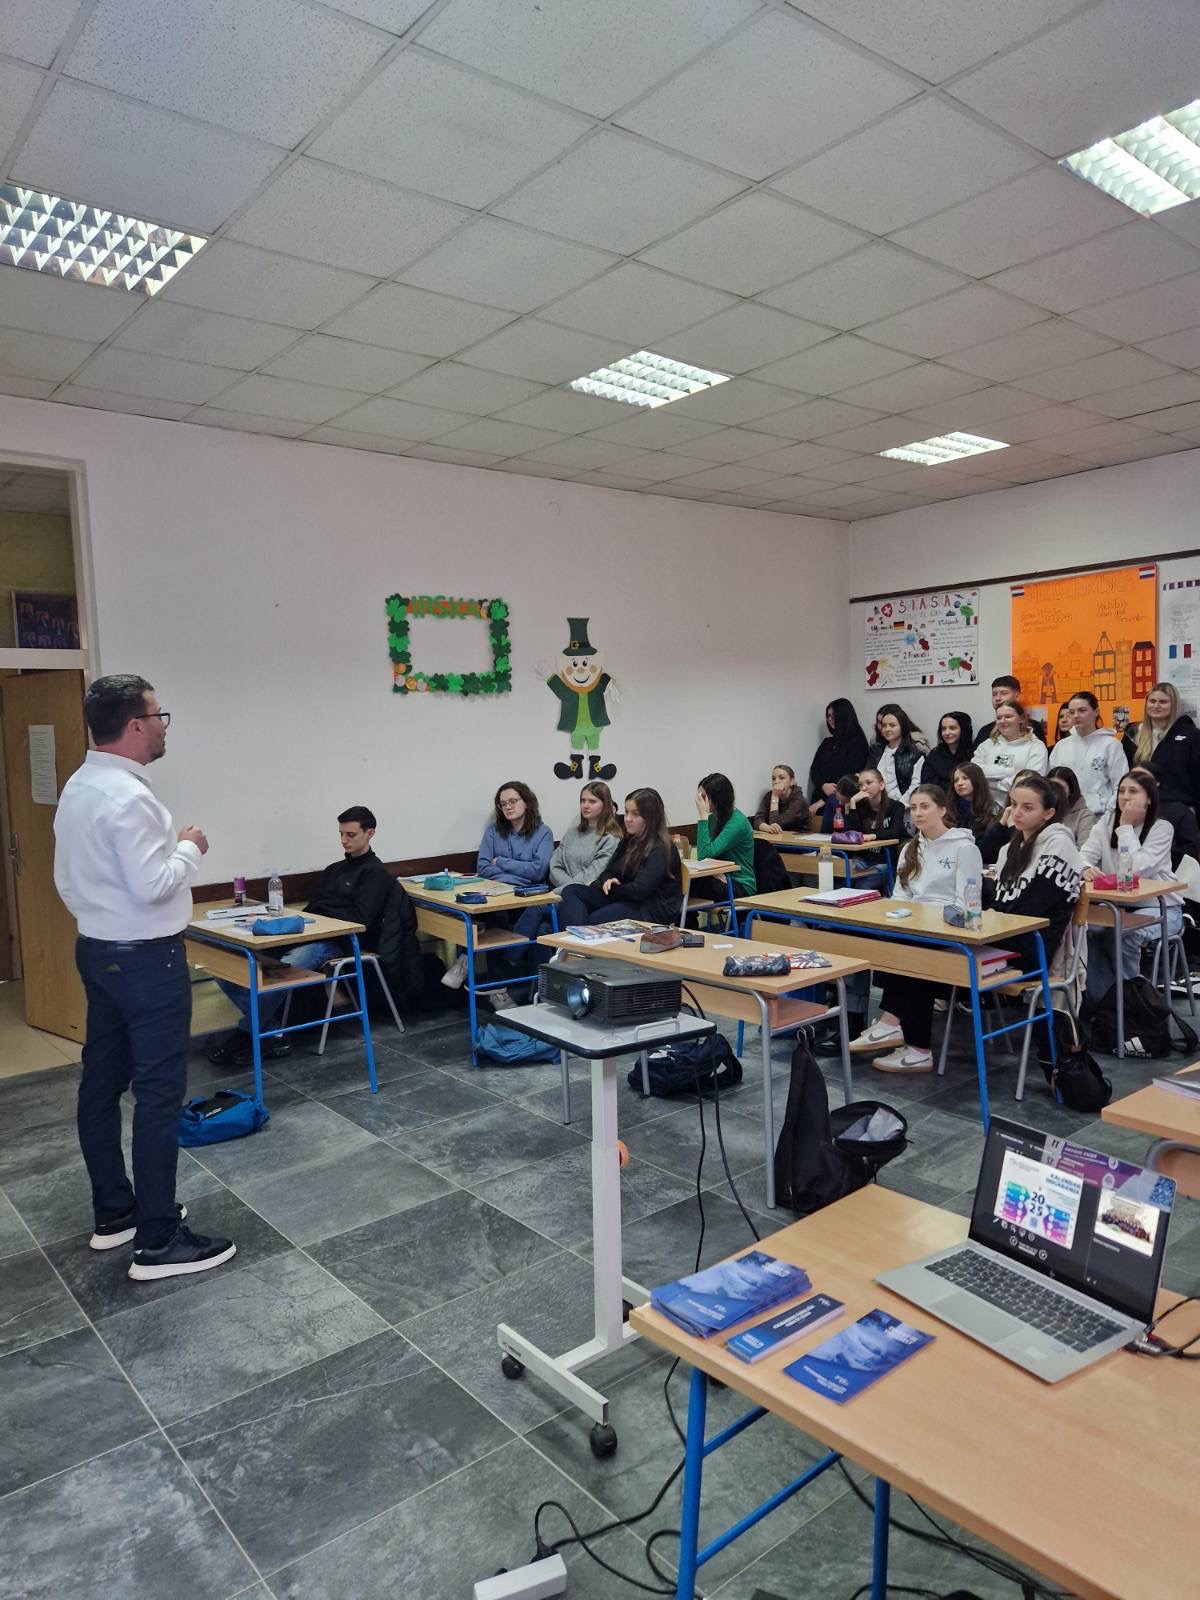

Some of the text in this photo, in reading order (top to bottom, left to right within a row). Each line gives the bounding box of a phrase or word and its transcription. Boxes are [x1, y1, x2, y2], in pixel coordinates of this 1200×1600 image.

[410, 595, 482, 619] IRSKA
[1031, 1191, 1045, 1205] 20
[1030, 1203, 1043, 1217] 25
